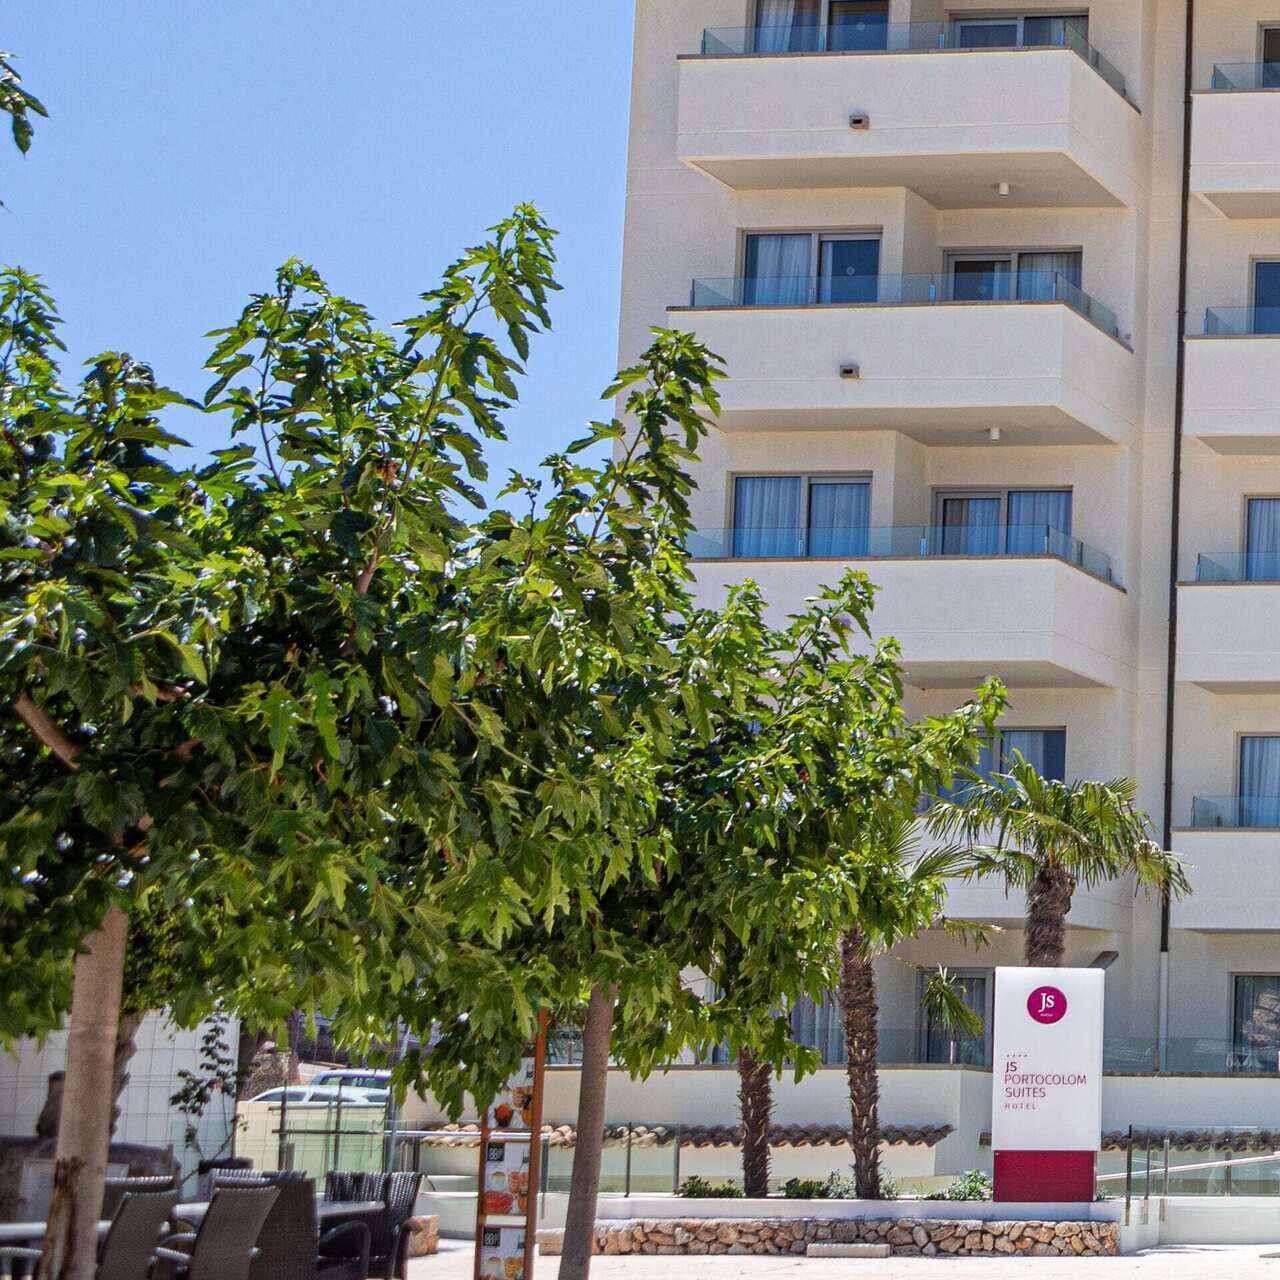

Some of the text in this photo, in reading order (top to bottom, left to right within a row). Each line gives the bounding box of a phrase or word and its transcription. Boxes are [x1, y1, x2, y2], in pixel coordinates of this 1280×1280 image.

[1038, 992, 1055, 1013] JS
[1005, 1061, 1018, 1073] JS
[1004, 1074, 1087, 1086] PORTOCOLOM
[1005, 1087, 1046, 1098] SUITES
[1004, 1102, 1037, 1110] HOTEL
